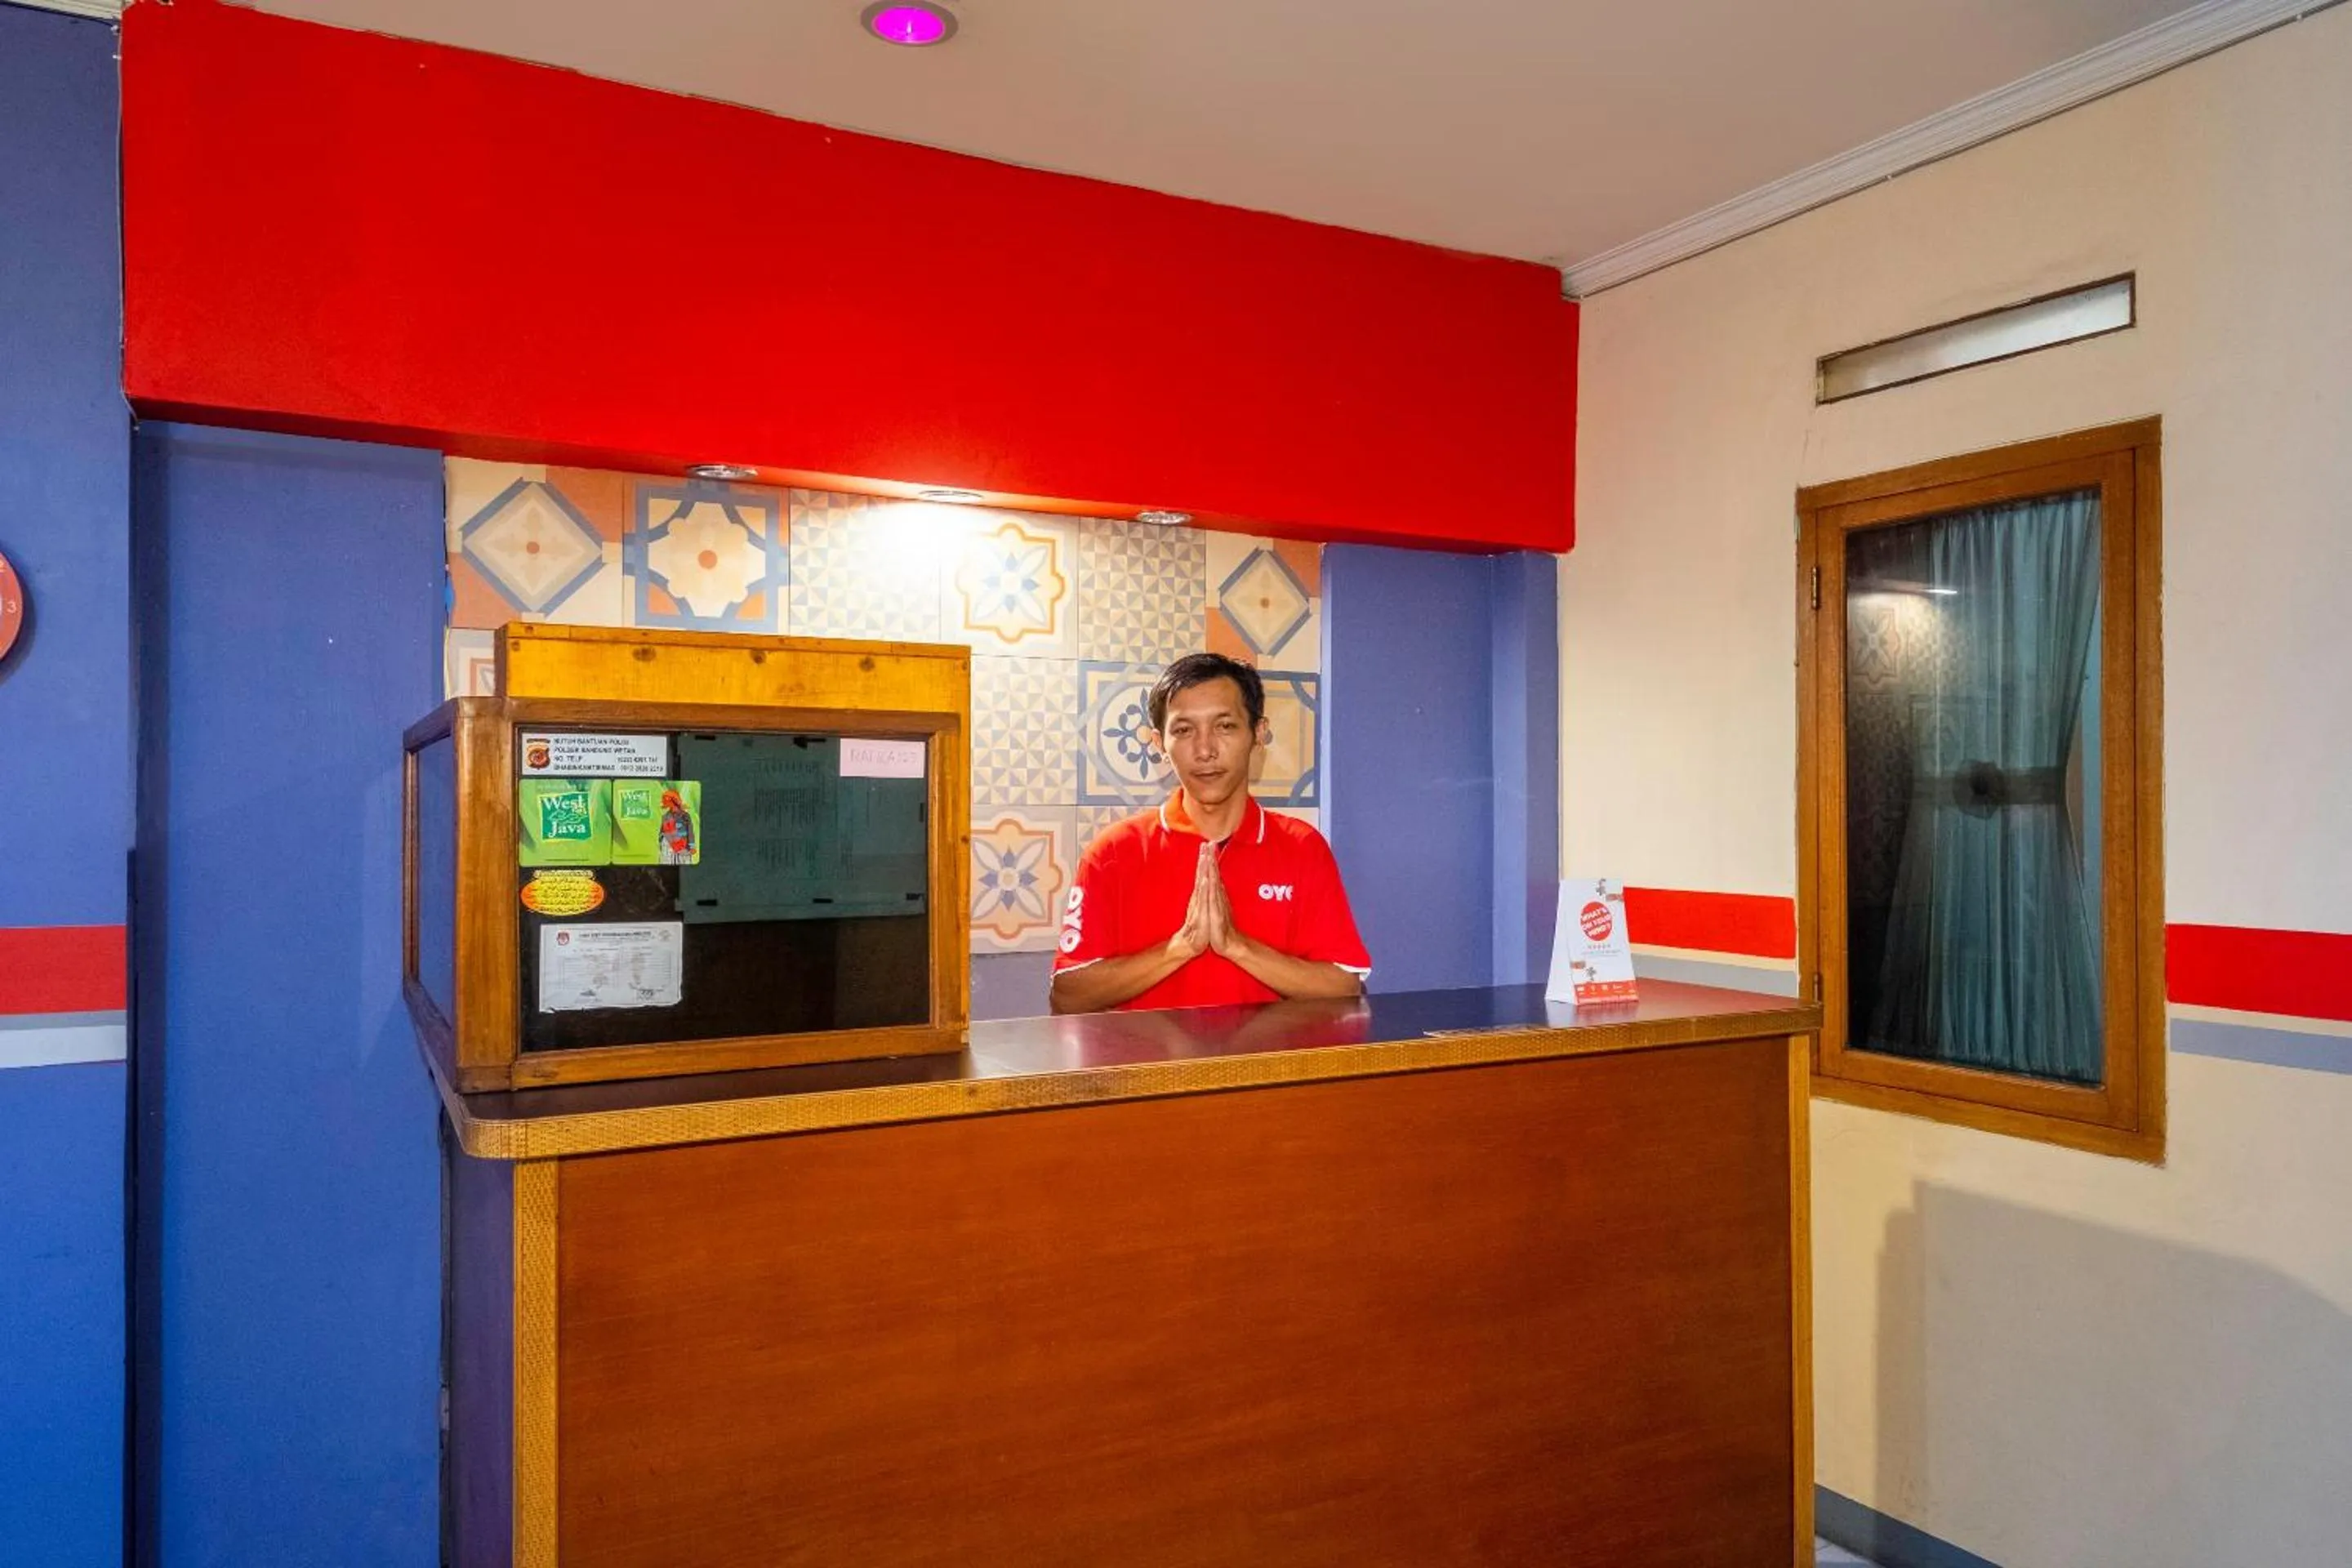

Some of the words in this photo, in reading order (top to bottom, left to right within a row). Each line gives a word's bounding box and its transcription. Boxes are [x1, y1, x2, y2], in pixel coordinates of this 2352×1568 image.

[7, 600, 17, 614] 3
[542, 795, 584, 810] West
[622, 791, 648, 802] West
[626, 807, 648, 816] Java
[548, 819, 586, 838] Java
[1059, 885, 1084, 954] OYO
